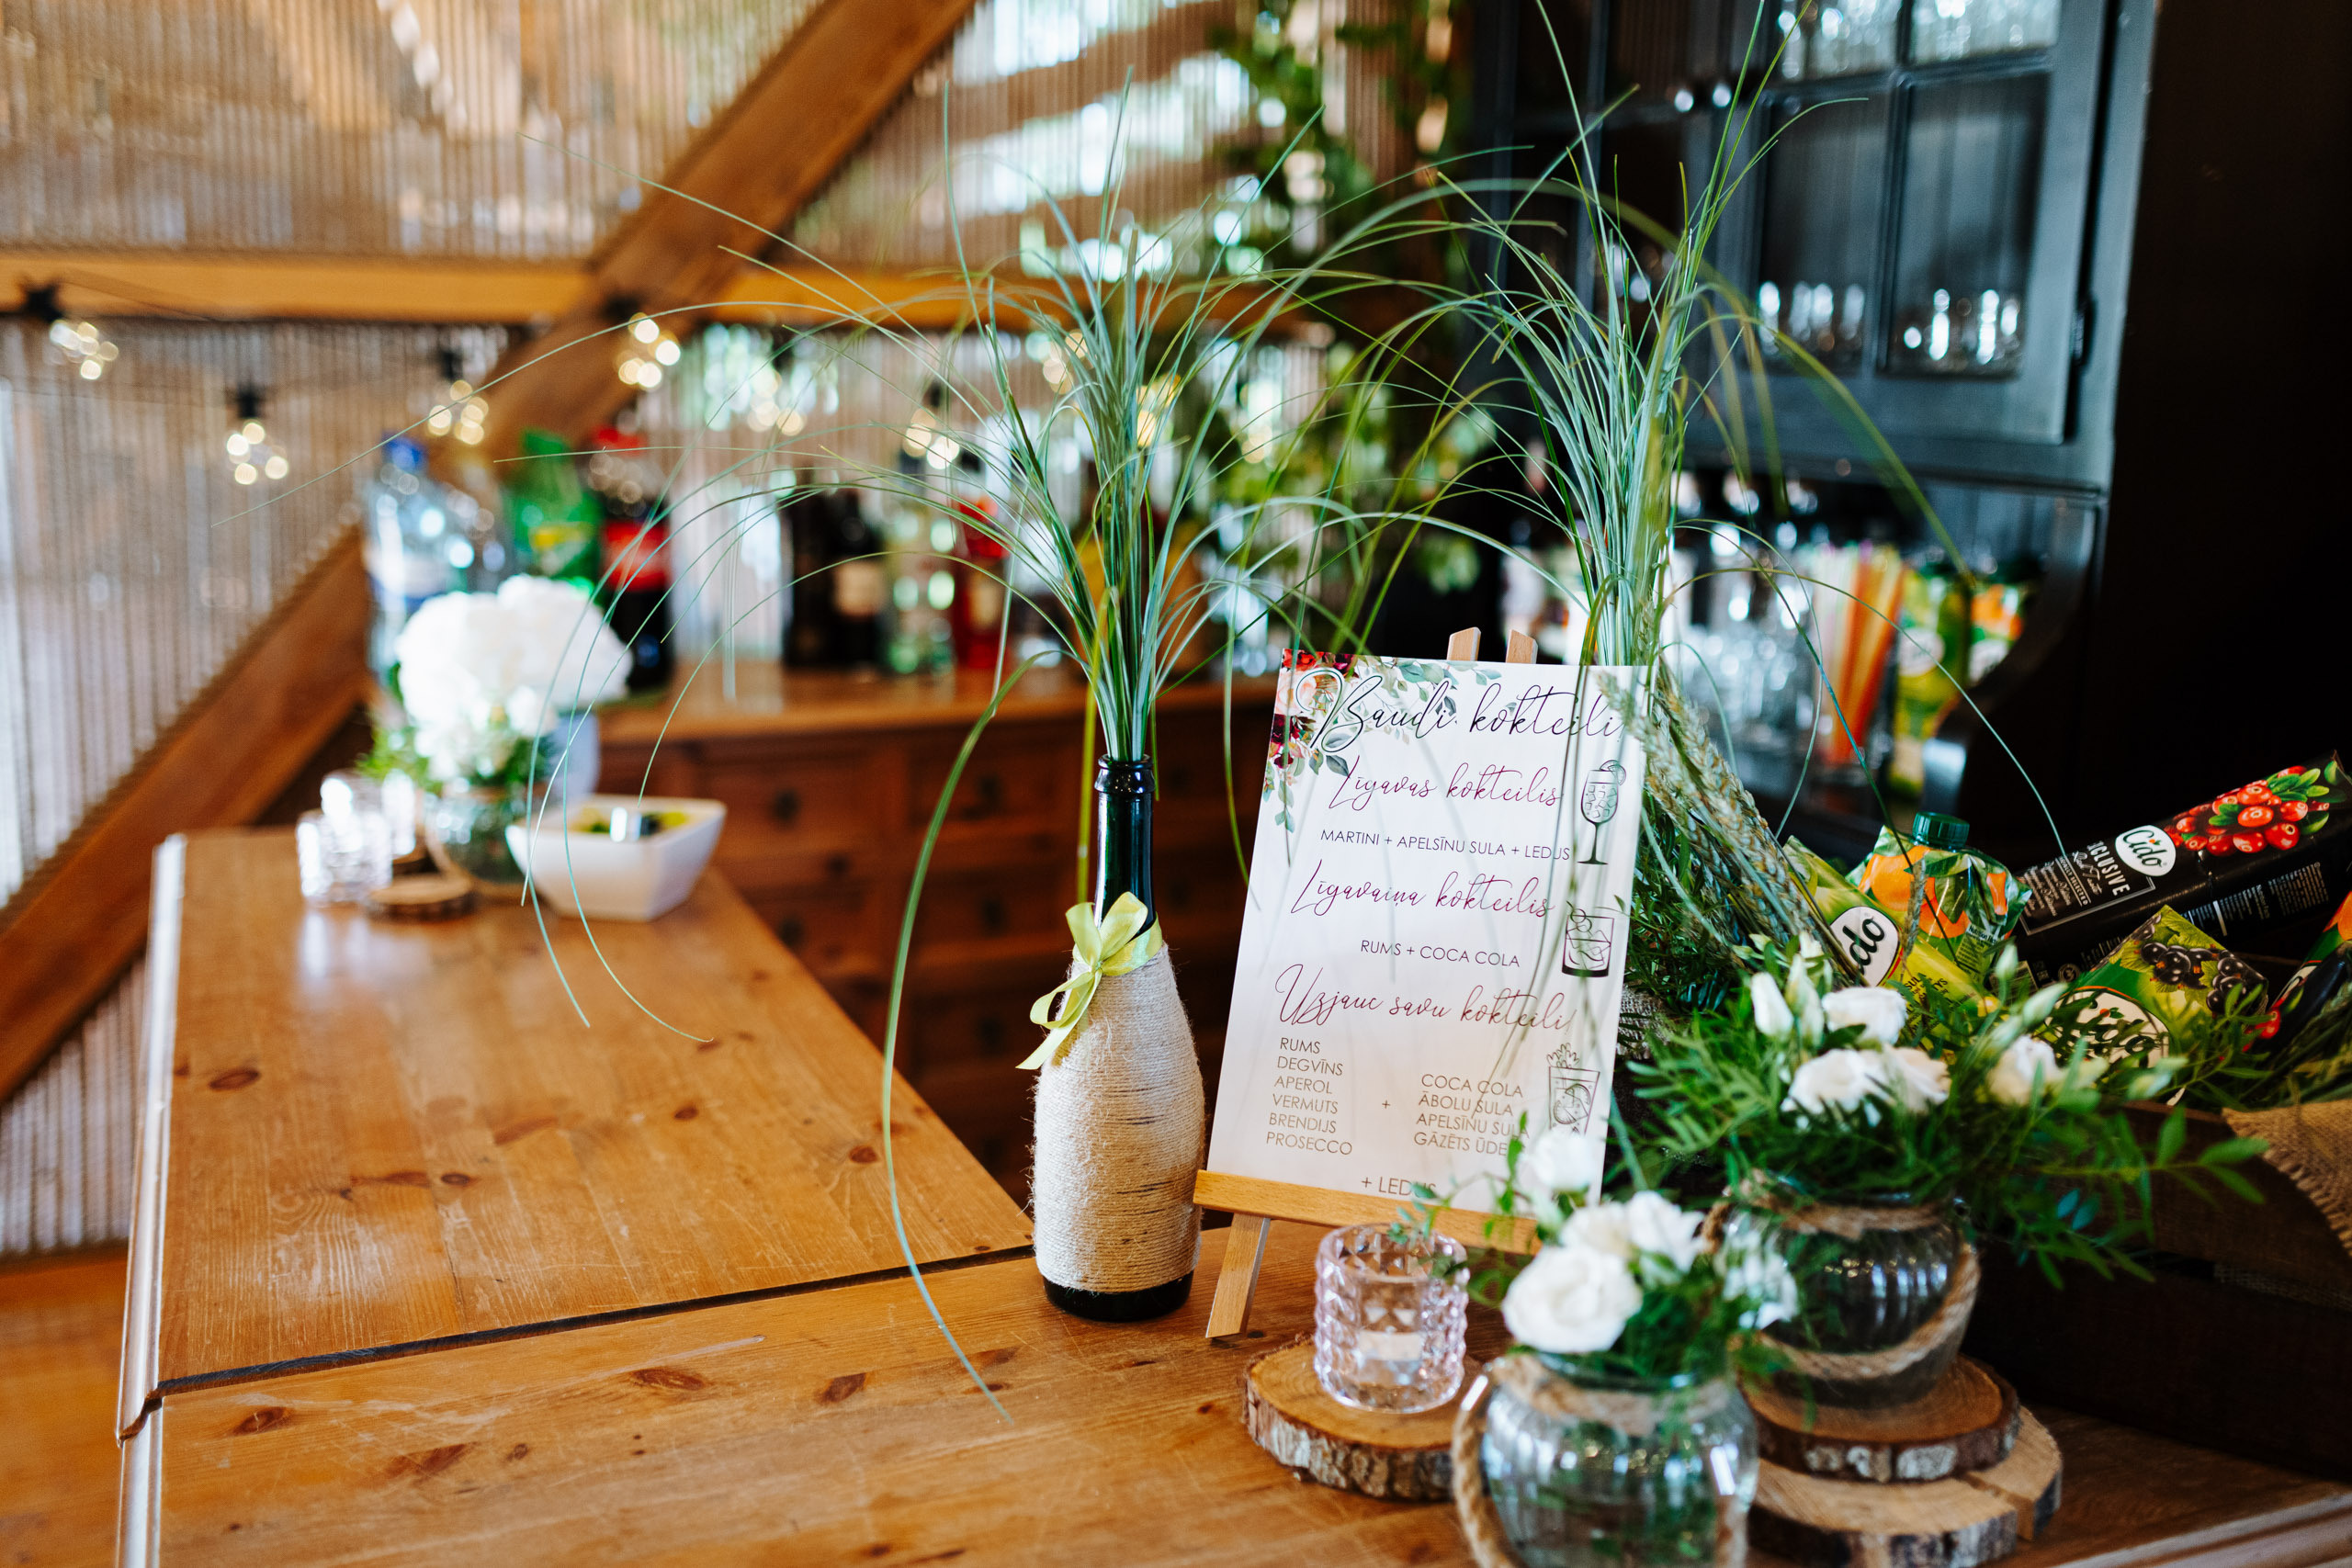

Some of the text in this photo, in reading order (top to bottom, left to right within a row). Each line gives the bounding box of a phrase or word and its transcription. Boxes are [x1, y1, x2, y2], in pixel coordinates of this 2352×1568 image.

[1329, 755, 1564, 811] Līgavas kokteilis
[1320, 829, 1570, 861] MARTINI + APELSĪNU SULA + LEDUS
[2122, 829, 2167, 868] Cido
[2086, 840, 2131, 896] CLUSIVE
[1291, 859, 1555, 918] Līgavaiņa kokteilis
[1361, 940, 1521, 967] RUMS + COCA COLA
[1842, 916, 1885, 976] do
[1389, 995, 1452, 1018] savu
[1280, 1037, 1320, 1055] RUMS
[1277, 1055, 1343, 1077] DEGVĪNS
[1274, 1076, 1332, 1095] APEROL
[1421, 1074, 1523, 1098] COCA COLA
[1272, 1093, 1339, 1114] VERMUTS
[1382, 1100, 1391, 1109] +
[1419, 1090, 1513, 1117] ĀBOLU SULA
[1269, 1112, 1338, 1134] BRENDIJS
[1416, 1113, 1530, 1140] APELSĪNU SULA
[1266, 1131, 1353, 1156] PROSECCO
[1414, 1132, 1525, 1156] GĀZĒTS ŪDE
[1361, 1176, 1436, 1197] + LED
